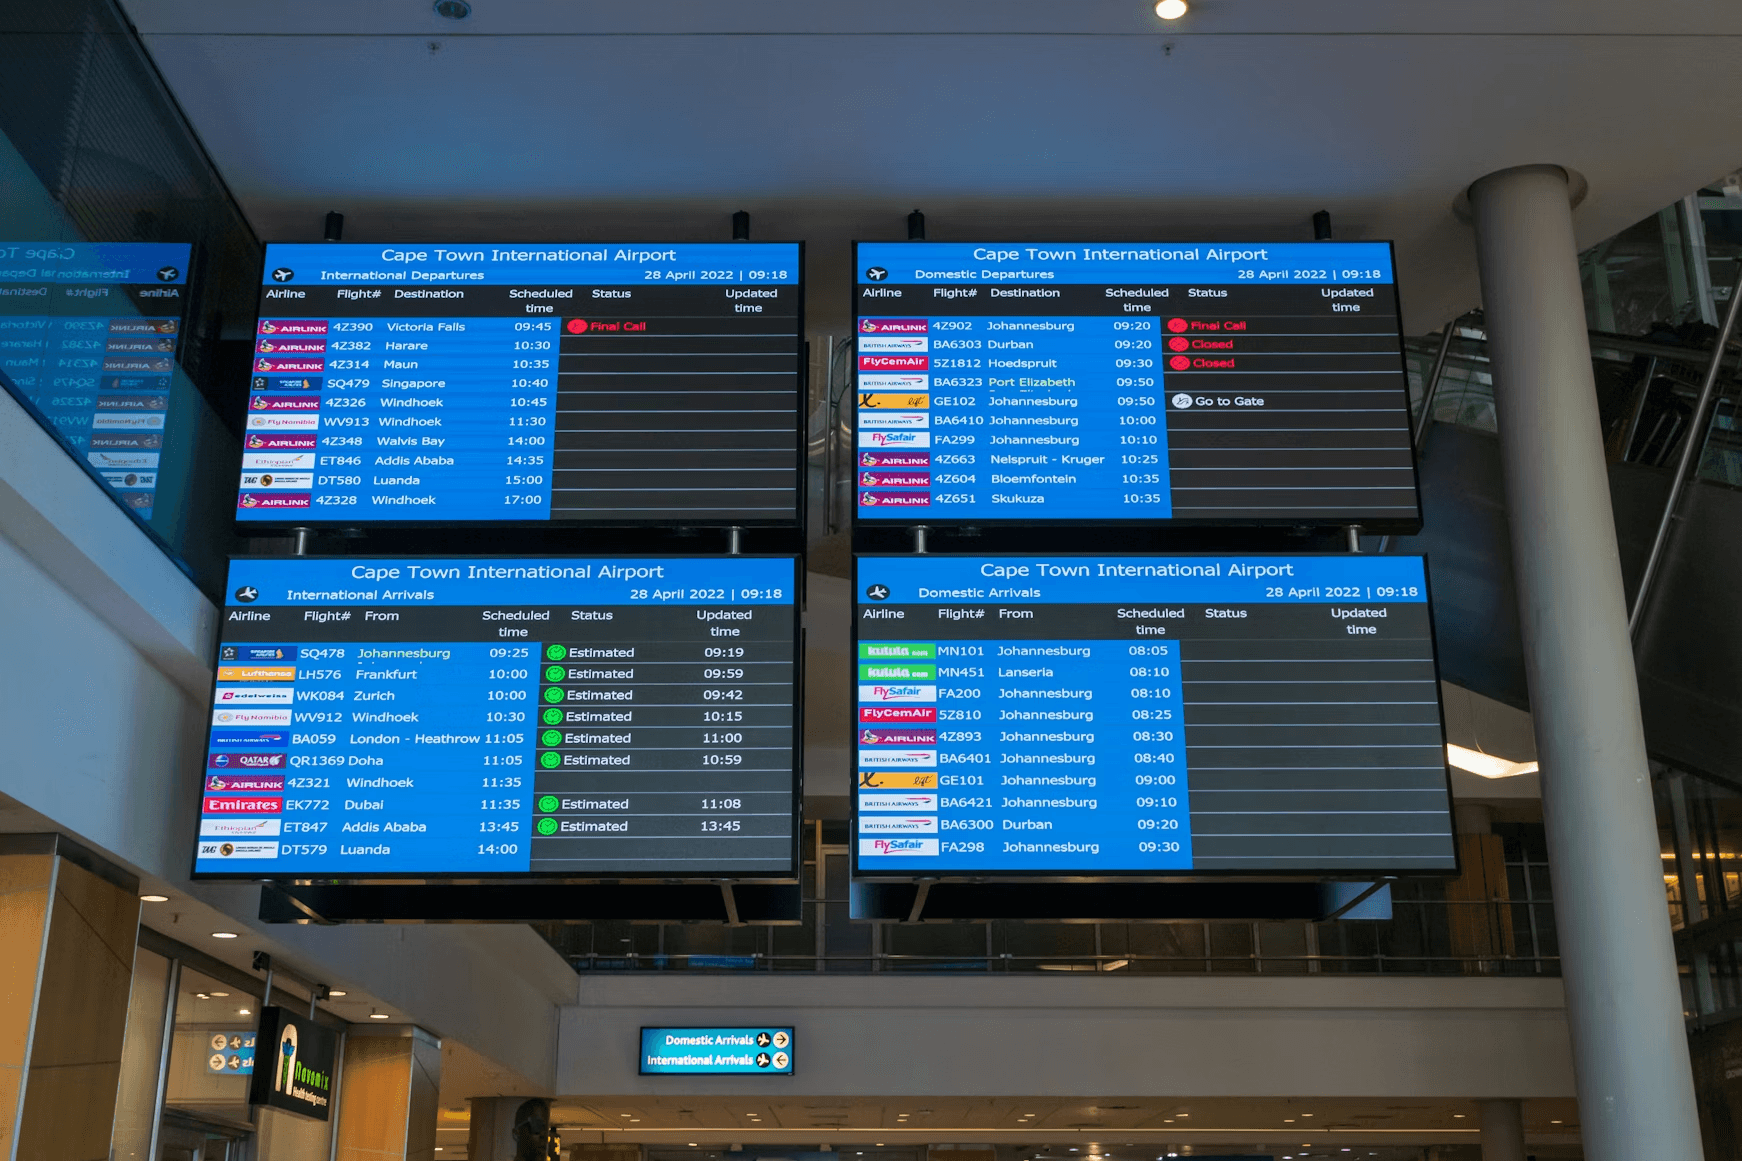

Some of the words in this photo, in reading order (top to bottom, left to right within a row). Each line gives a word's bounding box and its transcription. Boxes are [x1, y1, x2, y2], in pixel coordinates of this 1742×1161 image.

[382, 249, 427, 263] Cape
[434, 250, 484, 261] Town
[492, 249, 607, 261] International
[614, 250, 676, 263] Airport
[974, 248, 1019, 262] Cape
[1025, 248, 1076, 260] Town
[1084, 248, 1199, 260] International
[1206, 249, 1268, 263] Airport
[321, 271, 406, 280] International
[412, 271, 484, 282] Departures
[645, 271, 661, 279] 28
[666, 271, 695, 281] April
[700, 271, 733, 279] 2022
[749, 270, 787, 279] 09:18
[916, 270, 976, 278] Domestic
[982, 270, 1054, 280] Departures
[1238, 270, 1254, 278] 28
[1259, 270, 1288, 280] April
[1294, 270, 1326, 278] 2022
[1342, 270, 1381, 278] 09:18
[266, 289, 306, 298] Airline
[337, 289, 382, 300] Flight#
[394, 290, 464, 298] Destination
[509, 289, 573, 298] Scheduled
[592, 289, 631, 298] Status
[726, 289, 778, 300] Updated
[526, 304, 554, 313] time
[735, 304, 762, 312] time
[333, 323, 373, 331] 4Z390
[387, 323, 433, 331] Victoria
[438, 323, 465, 331] Falls
[515, 322, 551, 331] 09:45
[590, 322, 619, 331] Final
[623, 322, 646, 331] Call
[933, 322, 972, 330] 4Z902
[987, 322, 1074, 332] Johannesburg
[1114, 322, 1150, 330] 09:20
[1190, 322, 1220, 330] Final
[1224, 321, 1246, 330] Call
[331, 342, 371, 350] 4Z382
[386, 342, 428, 350] Harare
[515, 341, 550, 350] 10:30
[934, 340, 982, 348] BA6303
[988, 340, 1033, 348] Durban
[1115, 340, 1152, 348] 09:20
[1192, 340, 1233, 350] Closed
[934, 359, 981, 368] 5Z1812
[988, 359, 1057, 369] Hoedspruit
[1116, 359, 1153, 368] 09:30
[1193, 359, 1235, 368] Closed
[328, 379, 370, 390] SQ479
[382, 379, 446, 389] Singapore
[512, 379, 548, 388] 10:40
[934, 397, 976, 406] GE102
[989, 397, 1078, 407] Johannesburg
[1118, 397, 1155, 406] 09:50
[1196, 397, 1213, 406] Go
[1217, 397, 1231, 406] to
[1234, 396, 1264, 406] Gate
[324, 418, 369, 426] WV913
[379, 417, 442, 426] Windhoek
[510, 417, 546, 426] 11:30
[320, 456, 361, 465] ET846
[375, 456, 410, 465] Addis
[414, 456, 454, 465] Ababa
[508, 456, 544, 465] 14:35
[935, 474, 976, 483] 4Z604
[992, 474, 1076, 483] Bloemfontein
[1123, 474, 1159, 483] 10:35
[352, 566, 400, 582] Cape
[407, 566, 460, 578] Town
[468, 565, 590, 578] International
[598, 566, 664, 581] Airport
[981, 564, 1029, 579] Cape
[1036, 564, 1090, 576] Town
[1098, 563, 1220, 576] International
[1228, 564, 1294, 579] Airport
[287, 590, 377, 600] International
[382, 590, 434, 600] Arrivals
[630, 589, 648, 599] 28
[652, 589, 684, 601] April
[690, 589, 724, 599] 2022
[741, 589, 782, 599] 09:18
[919, 588, 984, 598] Domestic
[988, 588, 1040, 597] Arrivals
[1266, 587, 1283, 597] 28
[1288, 587, 1320, 599] April
[1326, 587, 1360, 597] 2022
[1377, 587, 1418, 596] 09:18
[863, 609, 904, 618] Airline
[938, 608, 985, 620] Flight#
[999, 608, 1033, 618] From
[1117, 608, 1185, 618] Scheduled
[1205, 608, 1247, 618] Status
[1331, 608, 1387, 620] Updated
[299, 670, 341, 679] LH576
[356, 669, 417, 679] Frankfurt
[490, 669, 528, 679] 10:00
[568, 668, 634, 679] Estimated
[704, 668, 744, 678] 09:59
[938, 668, 984, 677] MN451
[998, 668, 1053, 677] Lanseria
[1130, 667, 1169, 676] 08:10
[297, 691, 344, 700] WK084
[354, 691, 395, 700] Zurich
[488, 690, 526, 700] 10:00
[567, 690, 633, 700] Estimated
[703, 690, 743, 700] 09:42
[939, 710, 981, 720] 5Z810
[999, 710, 1093, 722] Johannesburg
[1132, 710, 1172, 720] 08:25
[209, 800, 278, 810] Emirates
[286, 800, 329, 810] EK772
[345, 800, 384, 810] Dubai
[482, 799, 520, 809] 11:35
[562, 798, 629, 810] Estimated
[702, 798, 742, 809] 11:08
[941, 820, 993, 830] BA6300
[1003, 819, 1052, 830] Durban
[1138, 819, 1178, 830] 09:20
[874, 840, 923, 854] FlySafair
[941, 843, 984, 852] FA298
[1003, 842, 1099, 854] Johannesburg
[1139, 842, 1180, 852] 09:30
[666, 1035, 714, 1045] Domestic
[715, 1034, 754, 1045] Arrivals
[648, 1054, 713, 1065] International
[714, 1054, 754, 1065] Arrivals
